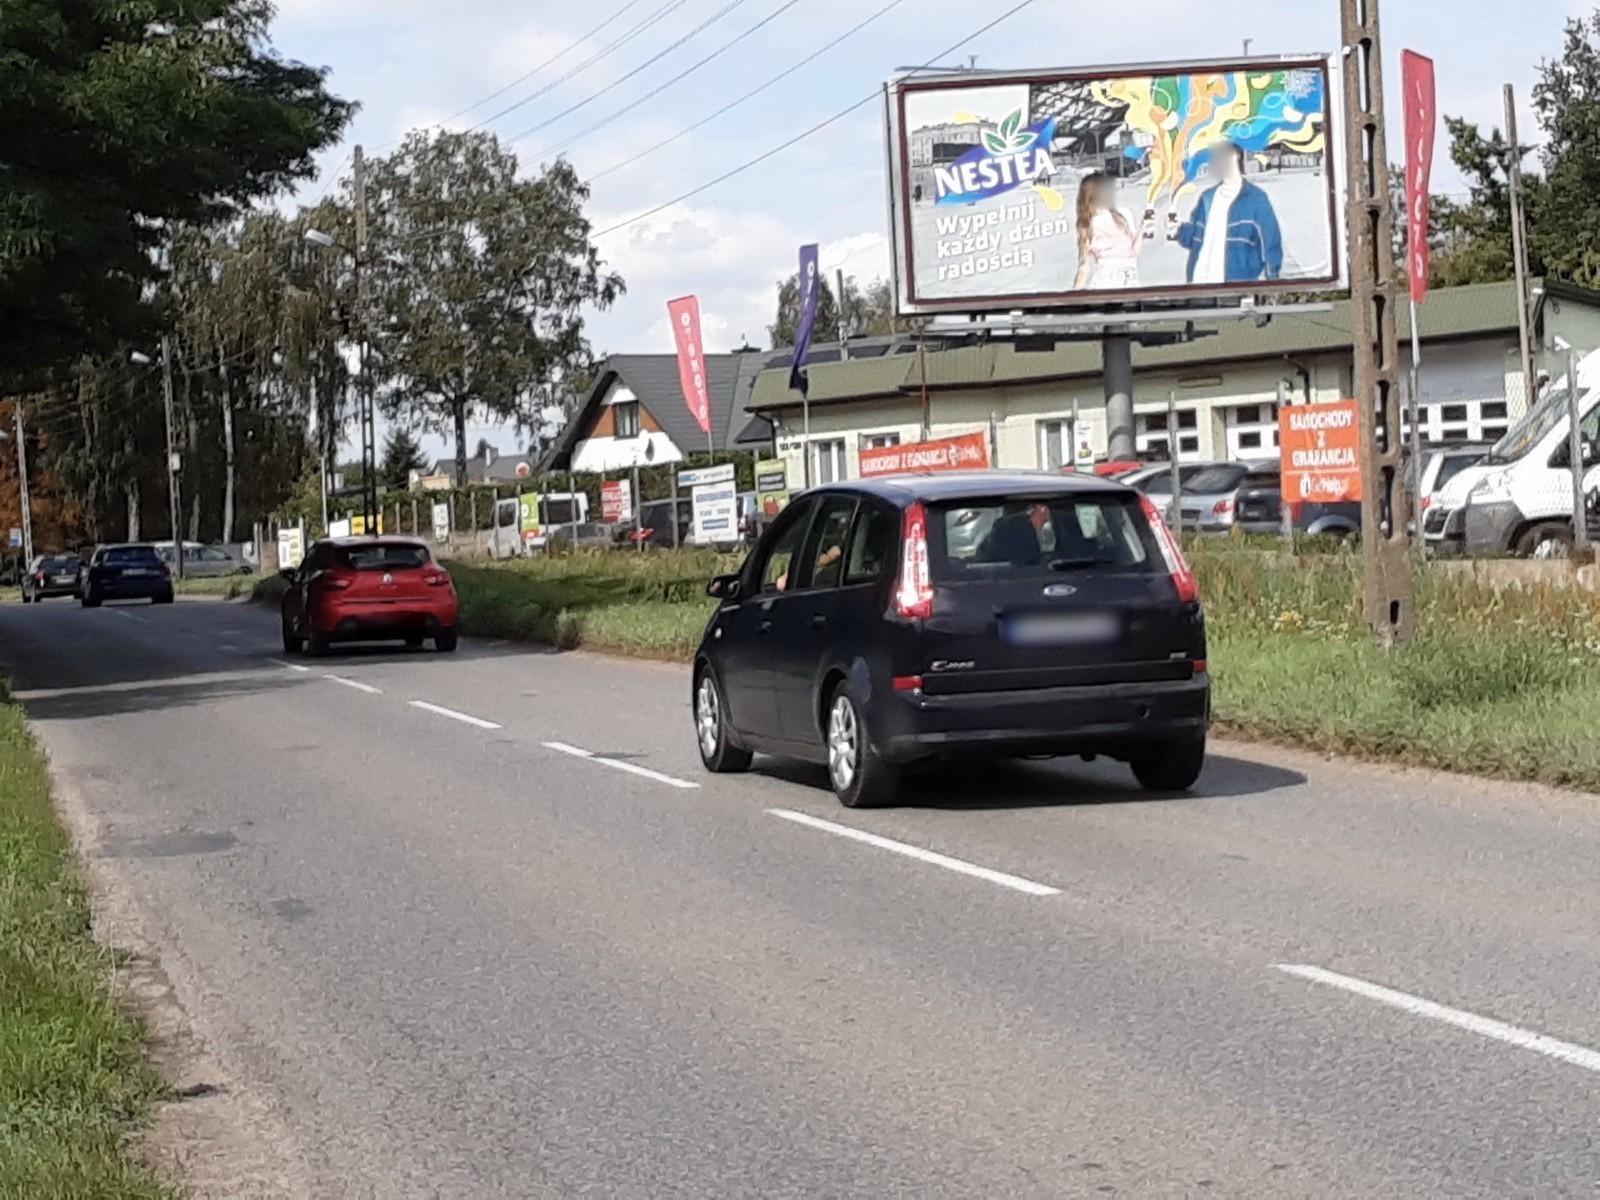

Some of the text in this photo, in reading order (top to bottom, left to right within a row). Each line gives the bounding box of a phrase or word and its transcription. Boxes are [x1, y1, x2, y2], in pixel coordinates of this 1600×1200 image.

[934, 148, 1058, 198] NESTEA
[936, 197, 1036, 236] Wypełnij
[938, 215, 1068, 258] każdy dzień
[939, 246, 1033, 280] radością
[1317, 430, 1326, 448] Z
